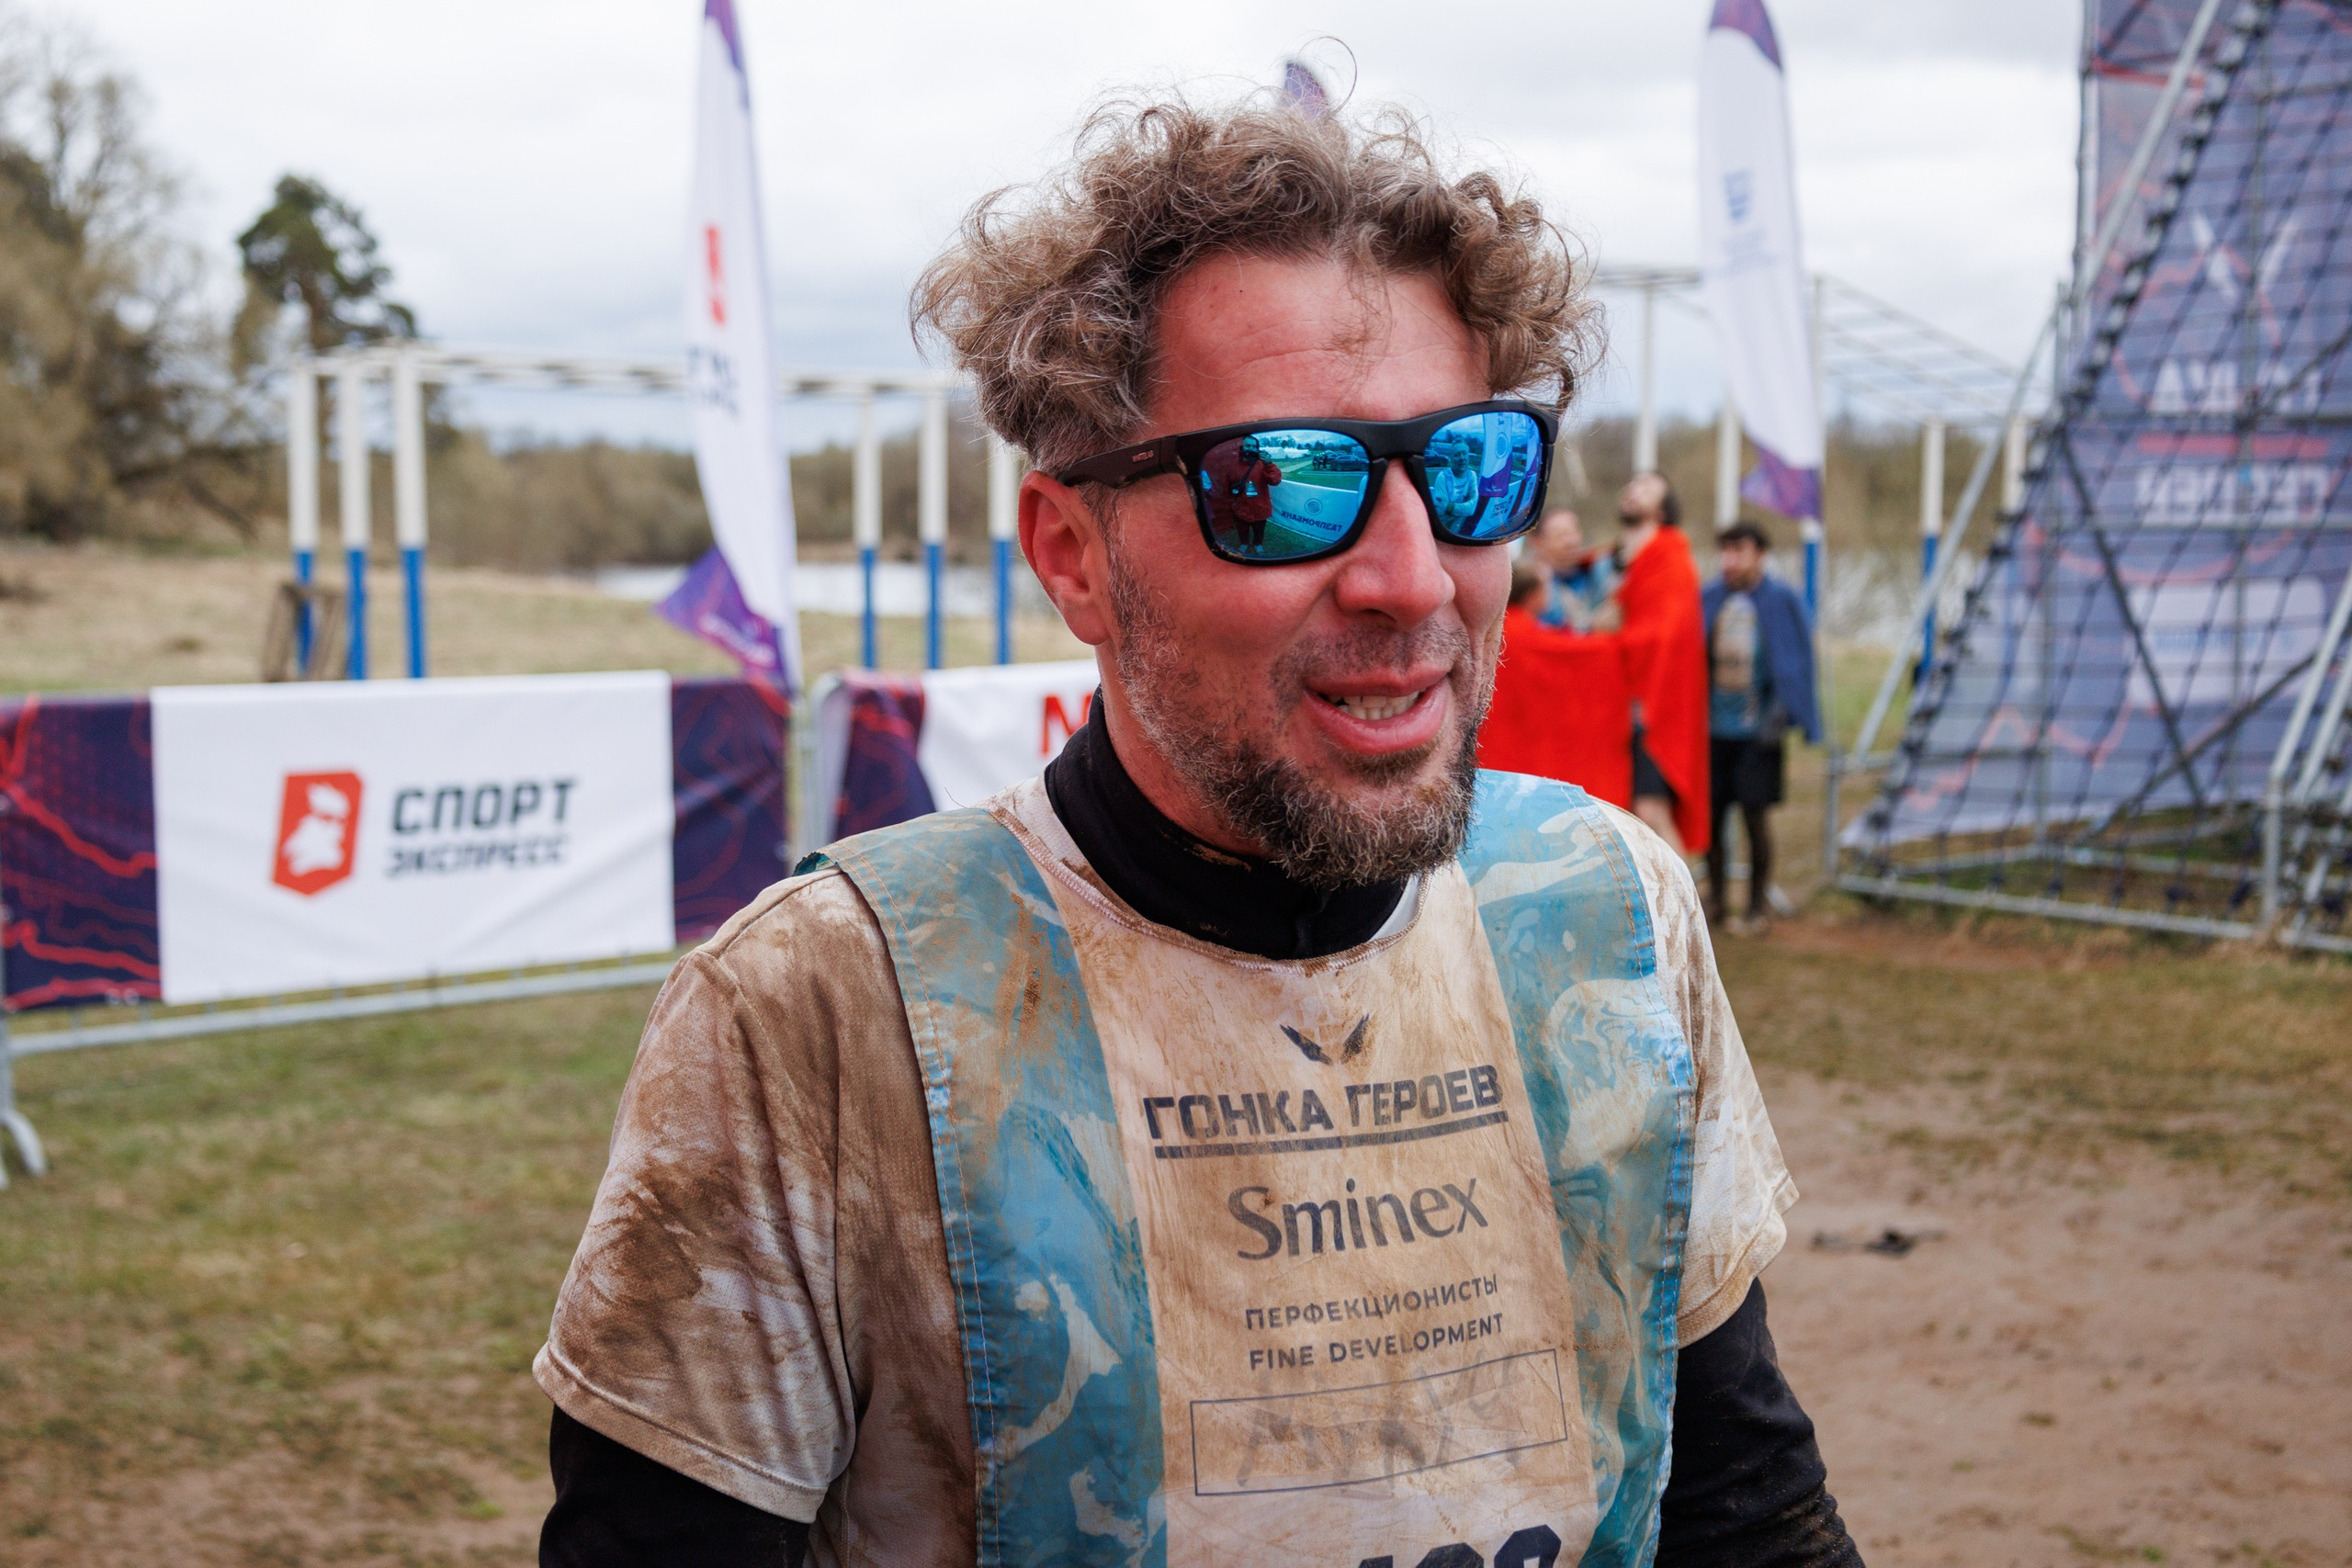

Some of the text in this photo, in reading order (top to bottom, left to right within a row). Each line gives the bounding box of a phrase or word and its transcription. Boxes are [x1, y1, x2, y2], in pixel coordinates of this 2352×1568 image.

[393, 778, 575, 833] СПОРТ
[1142, 1064, 1504, 1140] ГОНКА ГЕРОЕВ
[1228, 1179, 1488, 1260] Sminex
[1246, 1274, 1498, 1330] ПЕРФЕКЦИОНИСТЫ
[1250, 1314, 1504, 1371] FINE DEVELOPMENT
